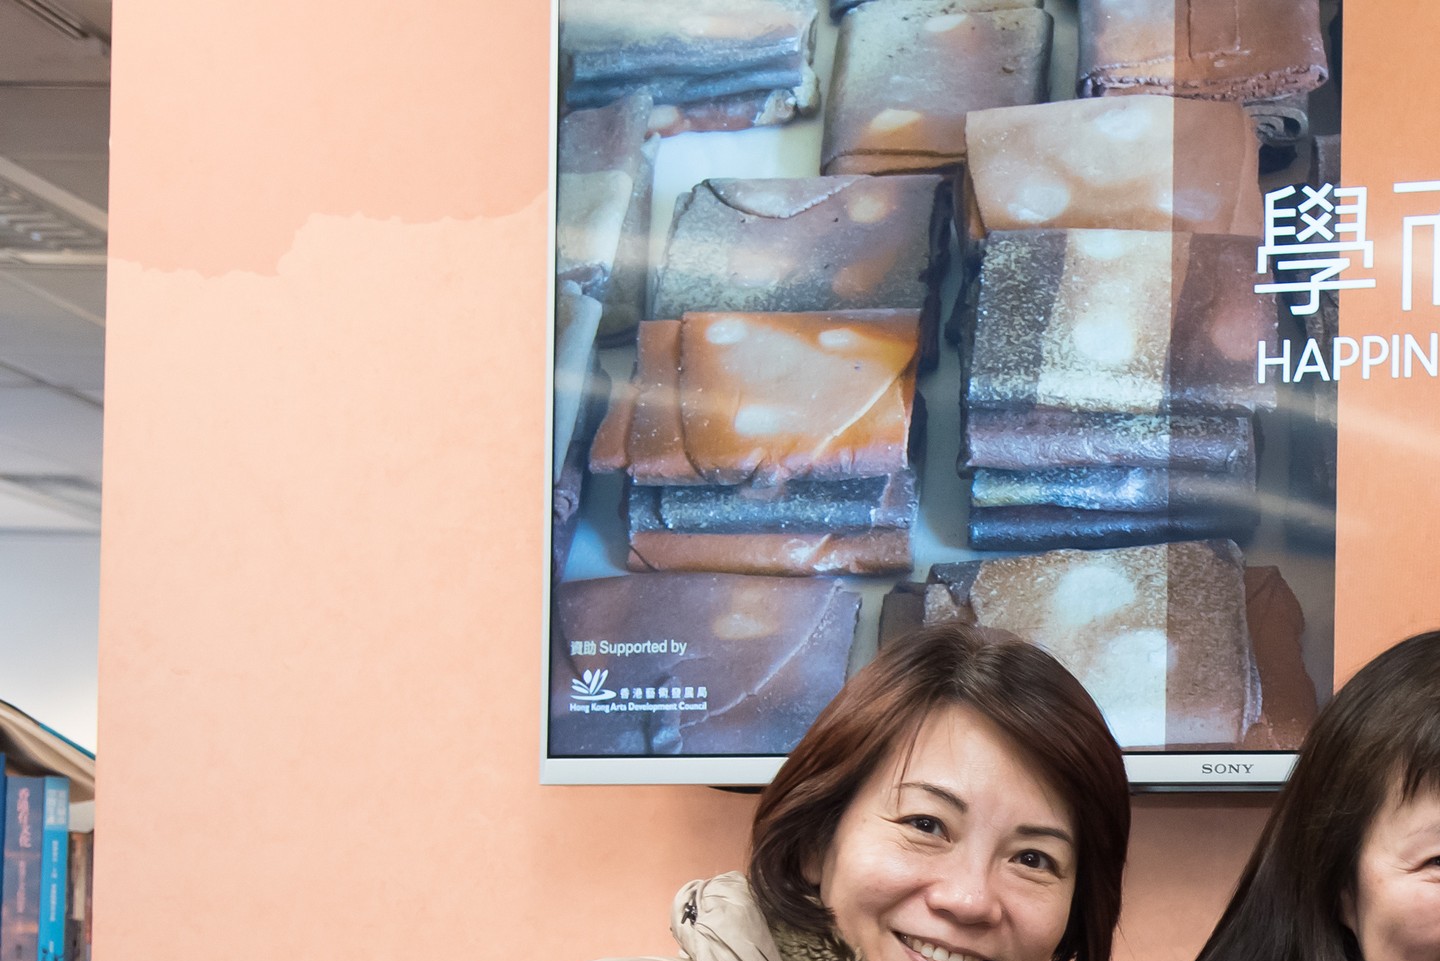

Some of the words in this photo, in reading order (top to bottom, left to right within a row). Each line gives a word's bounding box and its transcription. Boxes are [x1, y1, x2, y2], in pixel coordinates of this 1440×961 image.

[599, 640, 668, 657] Supported
[671, 639, 688, 656] by
[569, 703, 590, 713] Hong
[591, 702, 610, 713] Kong
[610, 702, 627, 711] Arts
[628, 701, 678, 713] Development
[678, 701, 707, 711] Council
[1201, 763, 1255, 775] SONY
